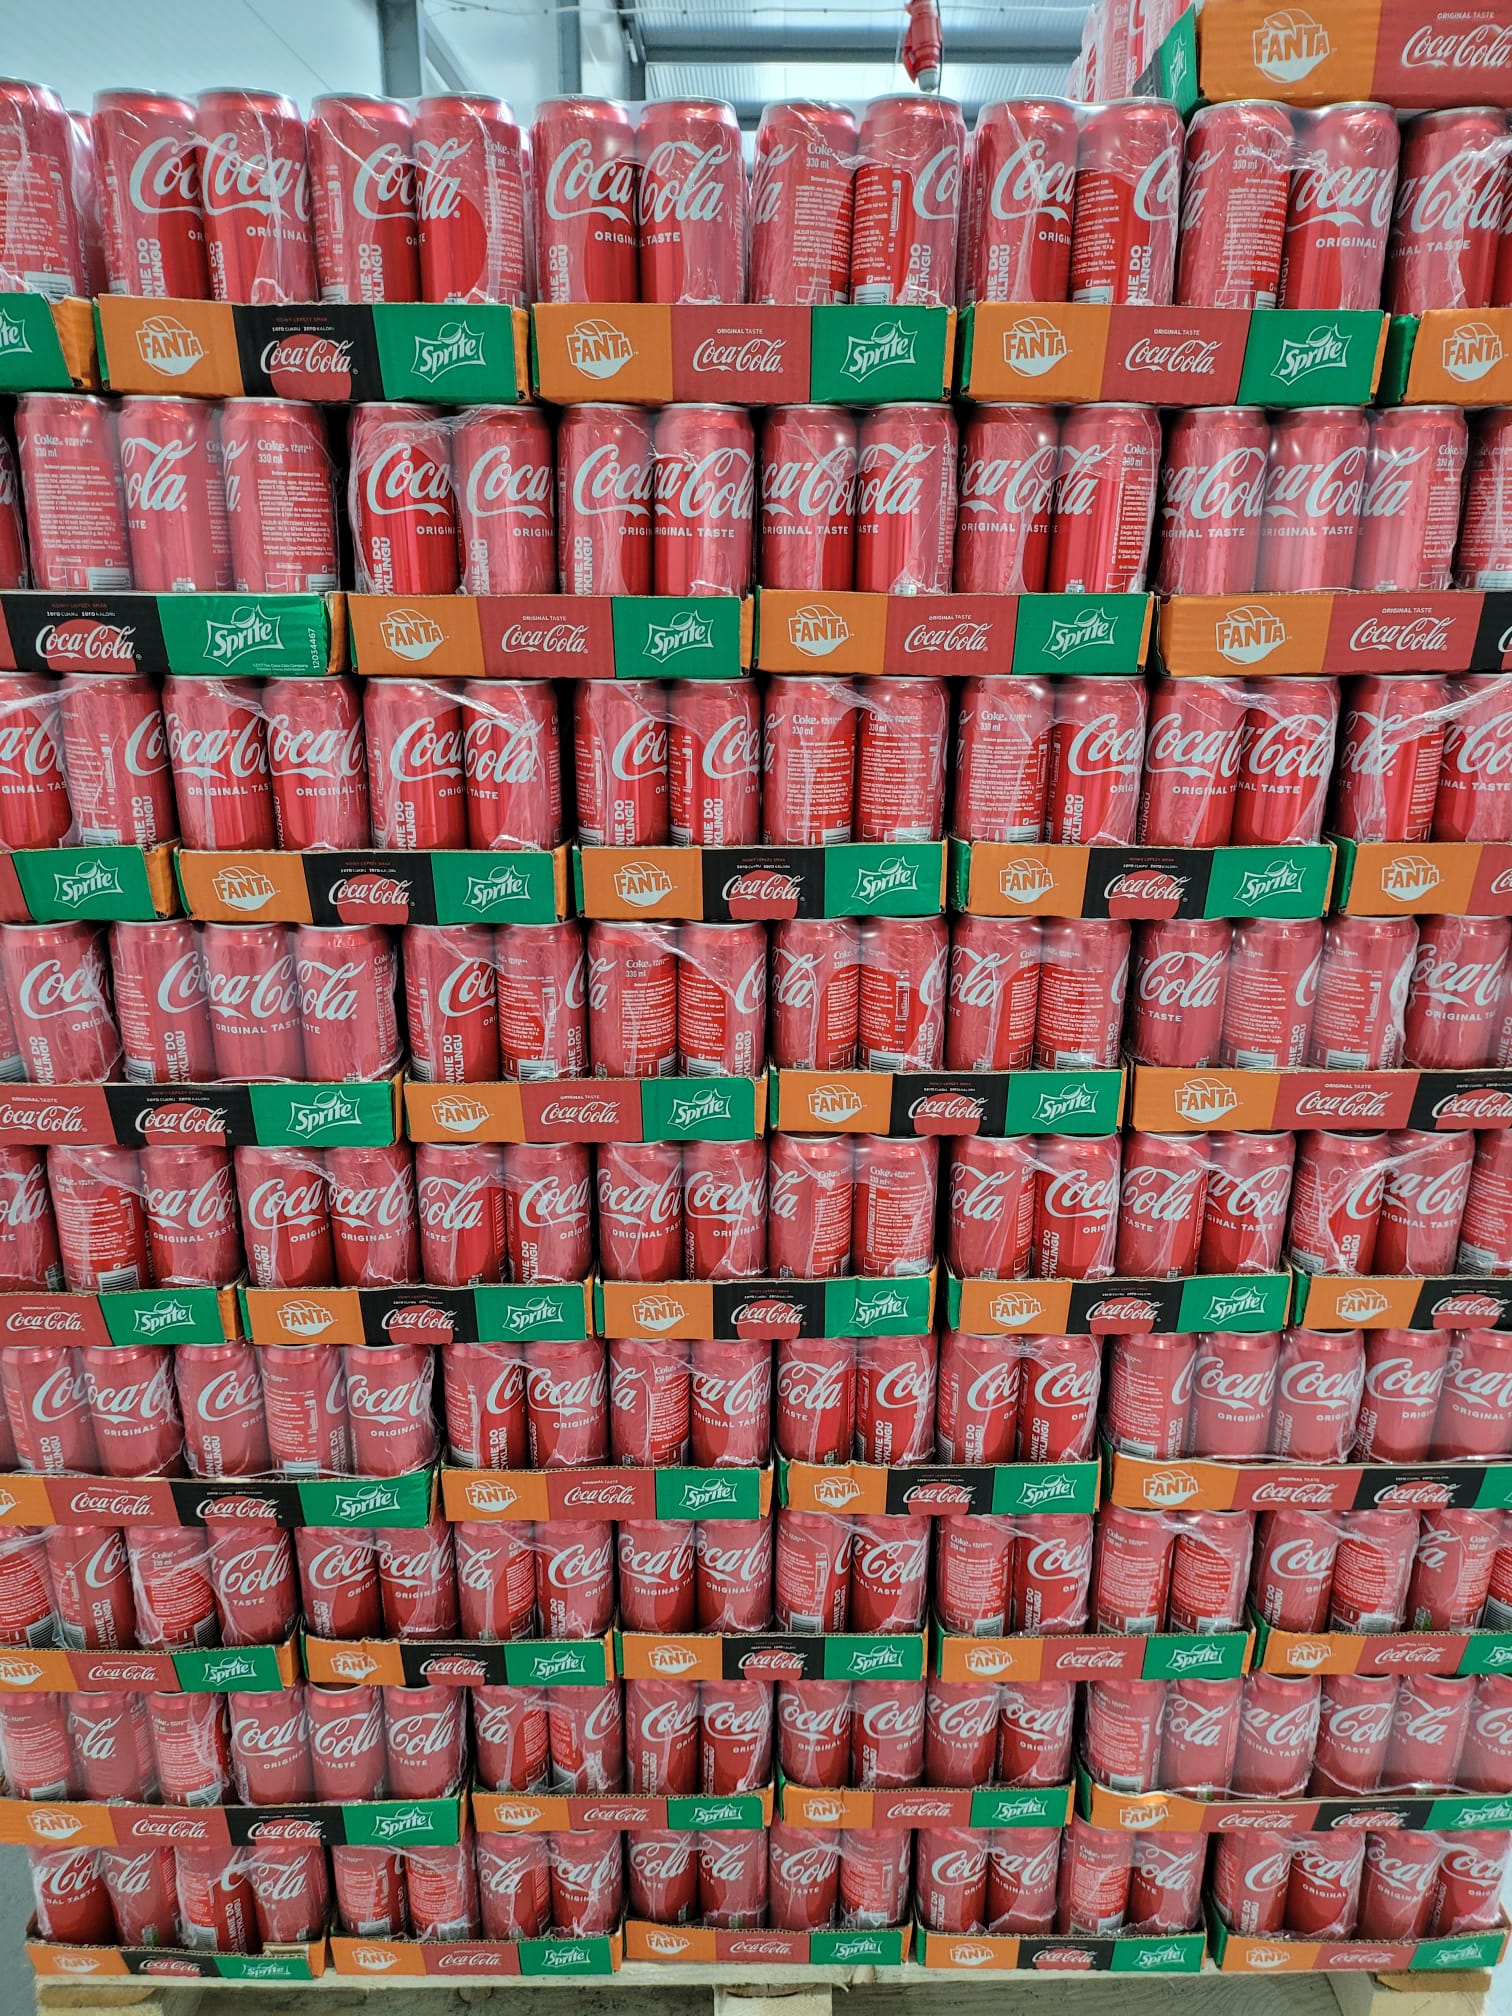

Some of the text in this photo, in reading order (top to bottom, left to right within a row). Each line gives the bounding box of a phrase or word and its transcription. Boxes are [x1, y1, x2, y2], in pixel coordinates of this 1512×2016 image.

[1437, 12, 1472, 20] ORIGINAL
[1402, 24, 1510, 68] Coca-Cola
[260, 340, 352, 373] Coca-Cola
[421, 340, 476, 370] Sprite
[693, 338, 787, 373] Coca-Cola
[850, 340, 908, 373] Sprite
[1125, 340, 1218, 374] Coca-Cola
[1285, 345, 1341, 375] Sprite
[36, 624, 137, 660] Coca-Cola
[216, 623, 272, 657] Sprite
[502, 624, 590, 654] Coca-Cola
[655, 627, 706, 657] Sprite
[904, 623, 994, 653] Coca-Cola
[1053, 623, 1109, 652] Sprite
[1349, 616, 1453, 652] Coca-Cola
[63, 872, 115, 901] Sprite
[328, 880, 416, 905] Coca-Cola
[473, 877, 525, 904] Sprite
[722, 875, 804, 901] Coca-Cola
[862, 868, 910, 896] Sprite
[1104, 873, 1190, 901] Coca-Cola
[1242, 870, 1299, 900] Sprite
[540, 1101, 617, 1124] Coca-Cola
[680, 1097, 725, 1124] Sprite
[908, 1096, 983, 1120] Coca-Cola
[1041, 1093, 1091, 1121] Sprite
[1296, 1089, 1392, 1116] Coca-Cola
[135, 1106, 227, 1133] Coca-Cola
[299, 1103, 352, 1130] Sprite
[142, 1306, 188, 1331] Sprite
[382, 1308, 456, 1330] Coca-Cola
[510, 1303, 557, 1328] Sprite
[731, 1302, 808, 1325] Coca-Cola
[860, 1299, 905, 1325] Sprite
[1085, 1299, 1163, 1323] Coca-Cola
[1215, 1295, 1262, 1321] Sprite
[1431, 1296, 1507, 1319] Coca-Cola
[7, 1310, 82, 1331] Coca-Cola
[71, 1492, 153, 1515] Coca-Cola
[340, 1493, 394, 1518] Sprite
[564, 1487, 633, 1505] Coca-Cola
[686, 1488, 731, 1507] Sprite
[903, 1484, 976, 1504] Coca-Cola
[1024, 1482, 1072, 1505] Sprite
[1252, 1482, 1334, 1504] Coca-Cola
[1374, 1484, 1457, 1505] Coca-Cola
[196, 1496, 280, 1519] Coca-Cola
[537, 1656, 581, 1676] Sprite
[854, 1649, 900, 1673] Sprite
[1173, 1649, 1220, 1668] Sprite
[209, 1661, 252, 1683] Sprite
[697, 1805, 738, 1823] Sprite
[999, 1800, 1045, 1817] Sprite
[1457, 1802, 1510, 1827] Sprite
[379, 1814, 427, 1835] Sprite
[547, 1949, 588, 1966] Sprite
[836, 1940, 880, 1957] Sprite
[1139, 1947, 1184, 1966] Sprite
[1441, 1946, 1482, 1964] Sprite
[246, 1965, 289, 1978] Sprite
